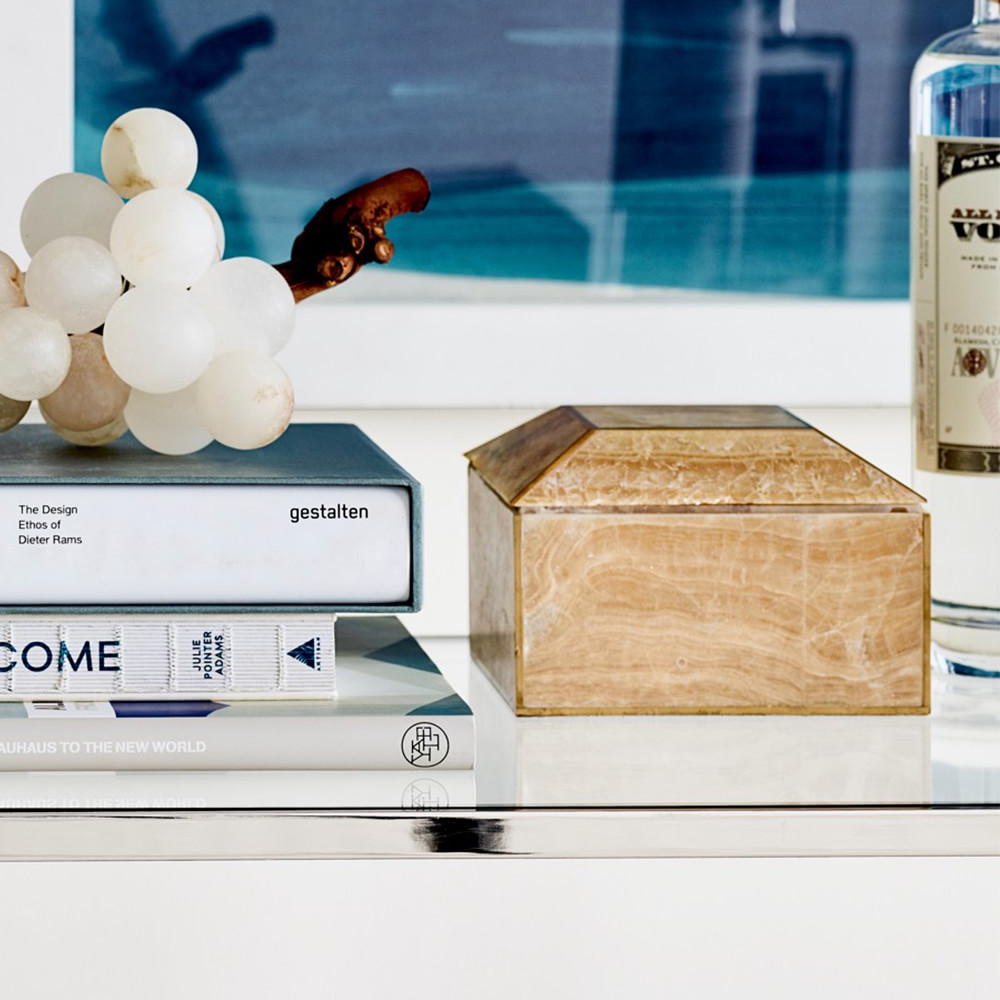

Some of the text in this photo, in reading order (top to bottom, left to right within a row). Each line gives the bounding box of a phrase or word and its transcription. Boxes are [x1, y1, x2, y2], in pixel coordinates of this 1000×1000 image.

[961, 154, 995, 169] ST.
[951, 208, 992, 219] ALL
[18, 504, 78, 518] The Design
[290, 503, 369, 523] gestalten
[18, 519, 61, 530] Ethos of
[18, 534, 83, 545] Dieter Rams
[192, 639, 202, 672] JULIE
[203, 631, 213, 680] POINTER
[215, 635, 225, 675] ADAMS
[59, 742, 81, 754] TO
[83, 741, 113, 753] THE
[115, 741, 150, 753] NEW
[152, 741, 207, 753] WORLD
